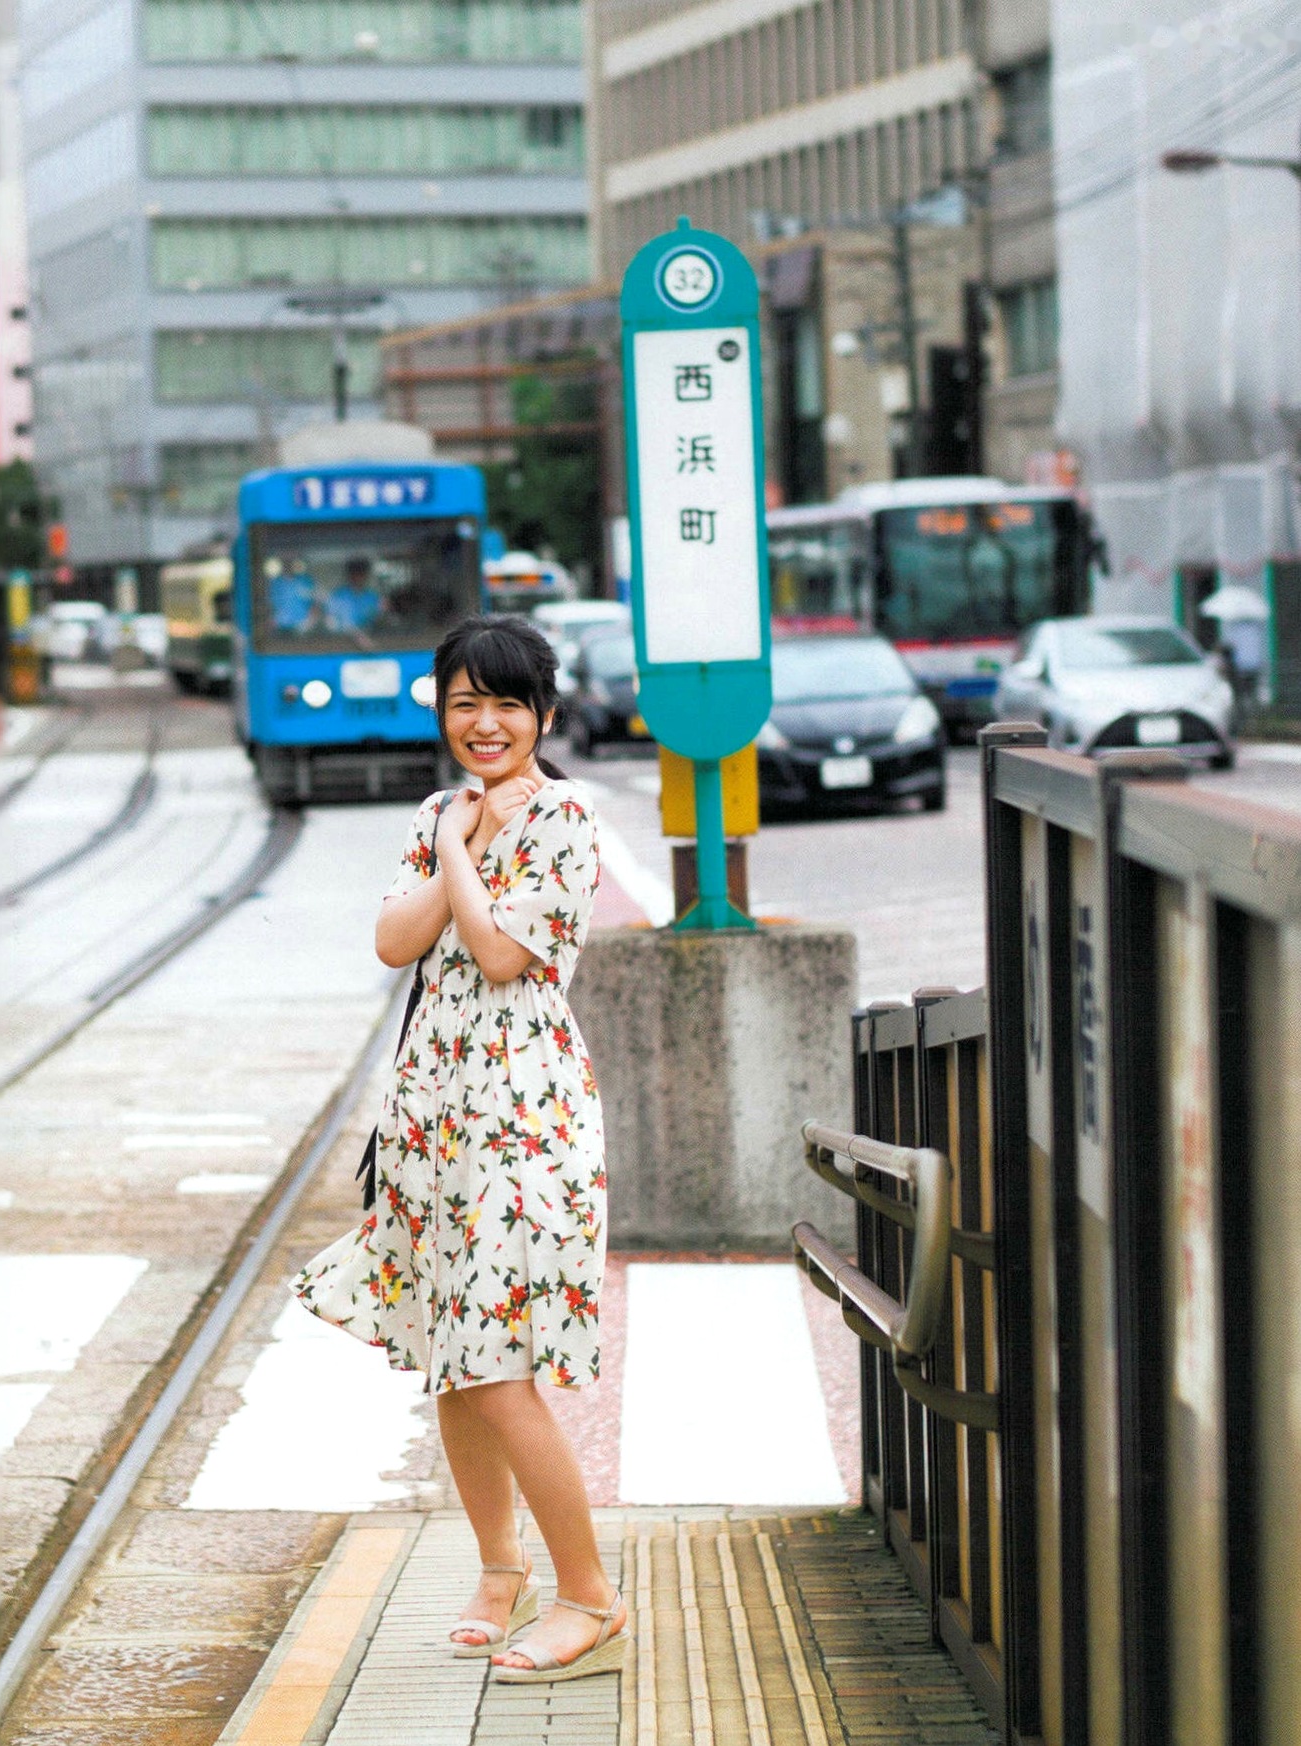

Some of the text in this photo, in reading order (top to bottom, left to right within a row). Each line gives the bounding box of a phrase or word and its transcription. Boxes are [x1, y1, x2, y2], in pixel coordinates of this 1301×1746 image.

[672, 266, 707, 292] 32
[674, 363, 718, 545] 西浜町
